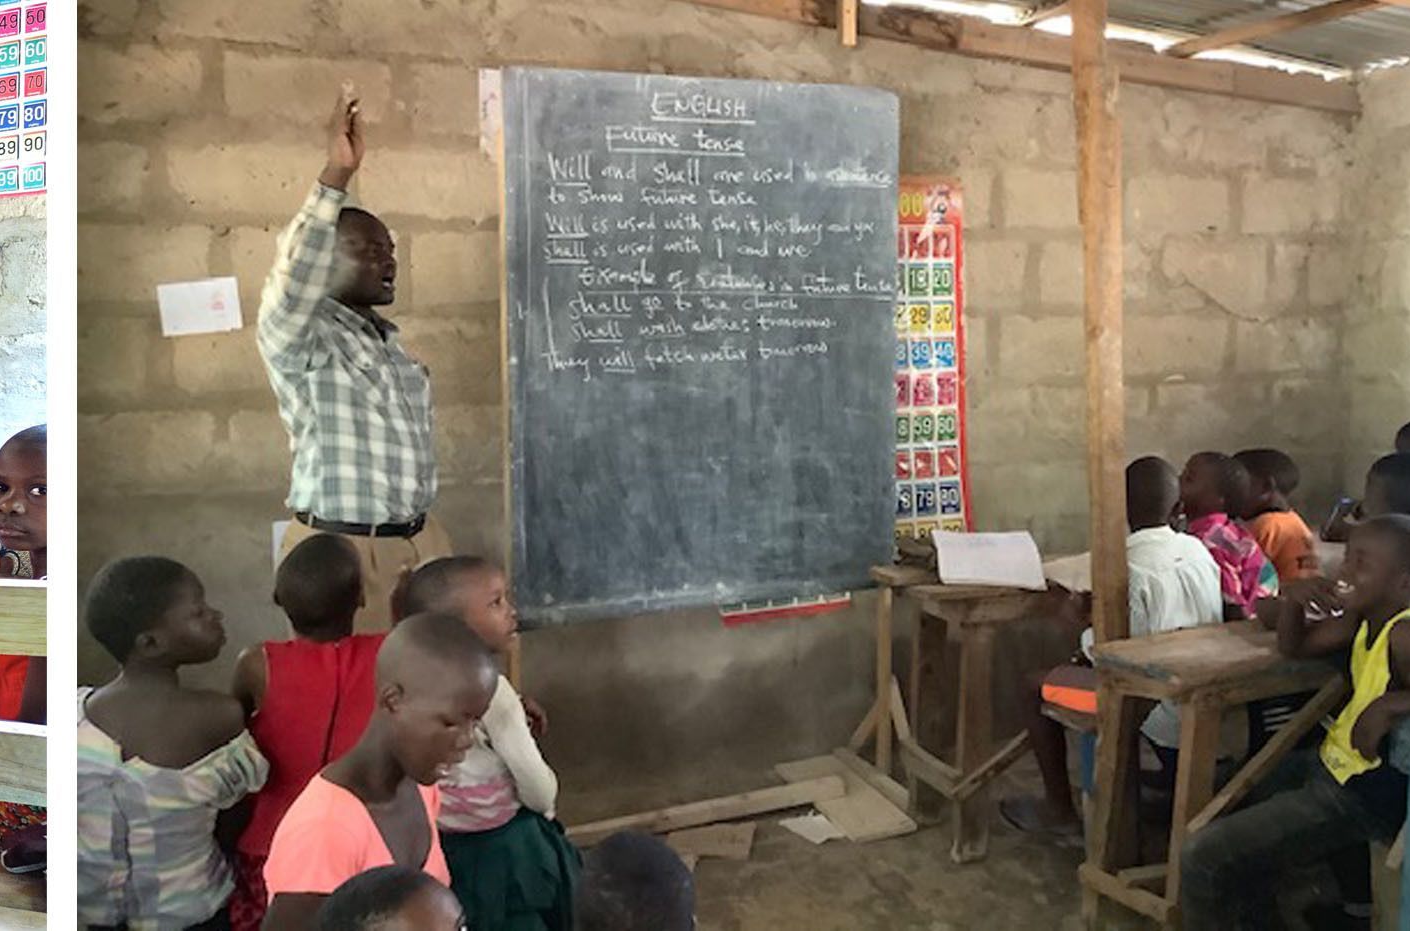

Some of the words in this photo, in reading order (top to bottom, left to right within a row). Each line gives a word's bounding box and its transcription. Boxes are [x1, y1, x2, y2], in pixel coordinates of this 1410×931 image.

[650, 92, 747, 118] ENGLISH
[0, 111, 17, 125] 79
[25, 106, 45, 121] 80
[25, 137, 44, 151] 90
[24, 168, 43, 182] 100
[548, 152, 591, 180] Will
[910, 270, 927, 289] 19
